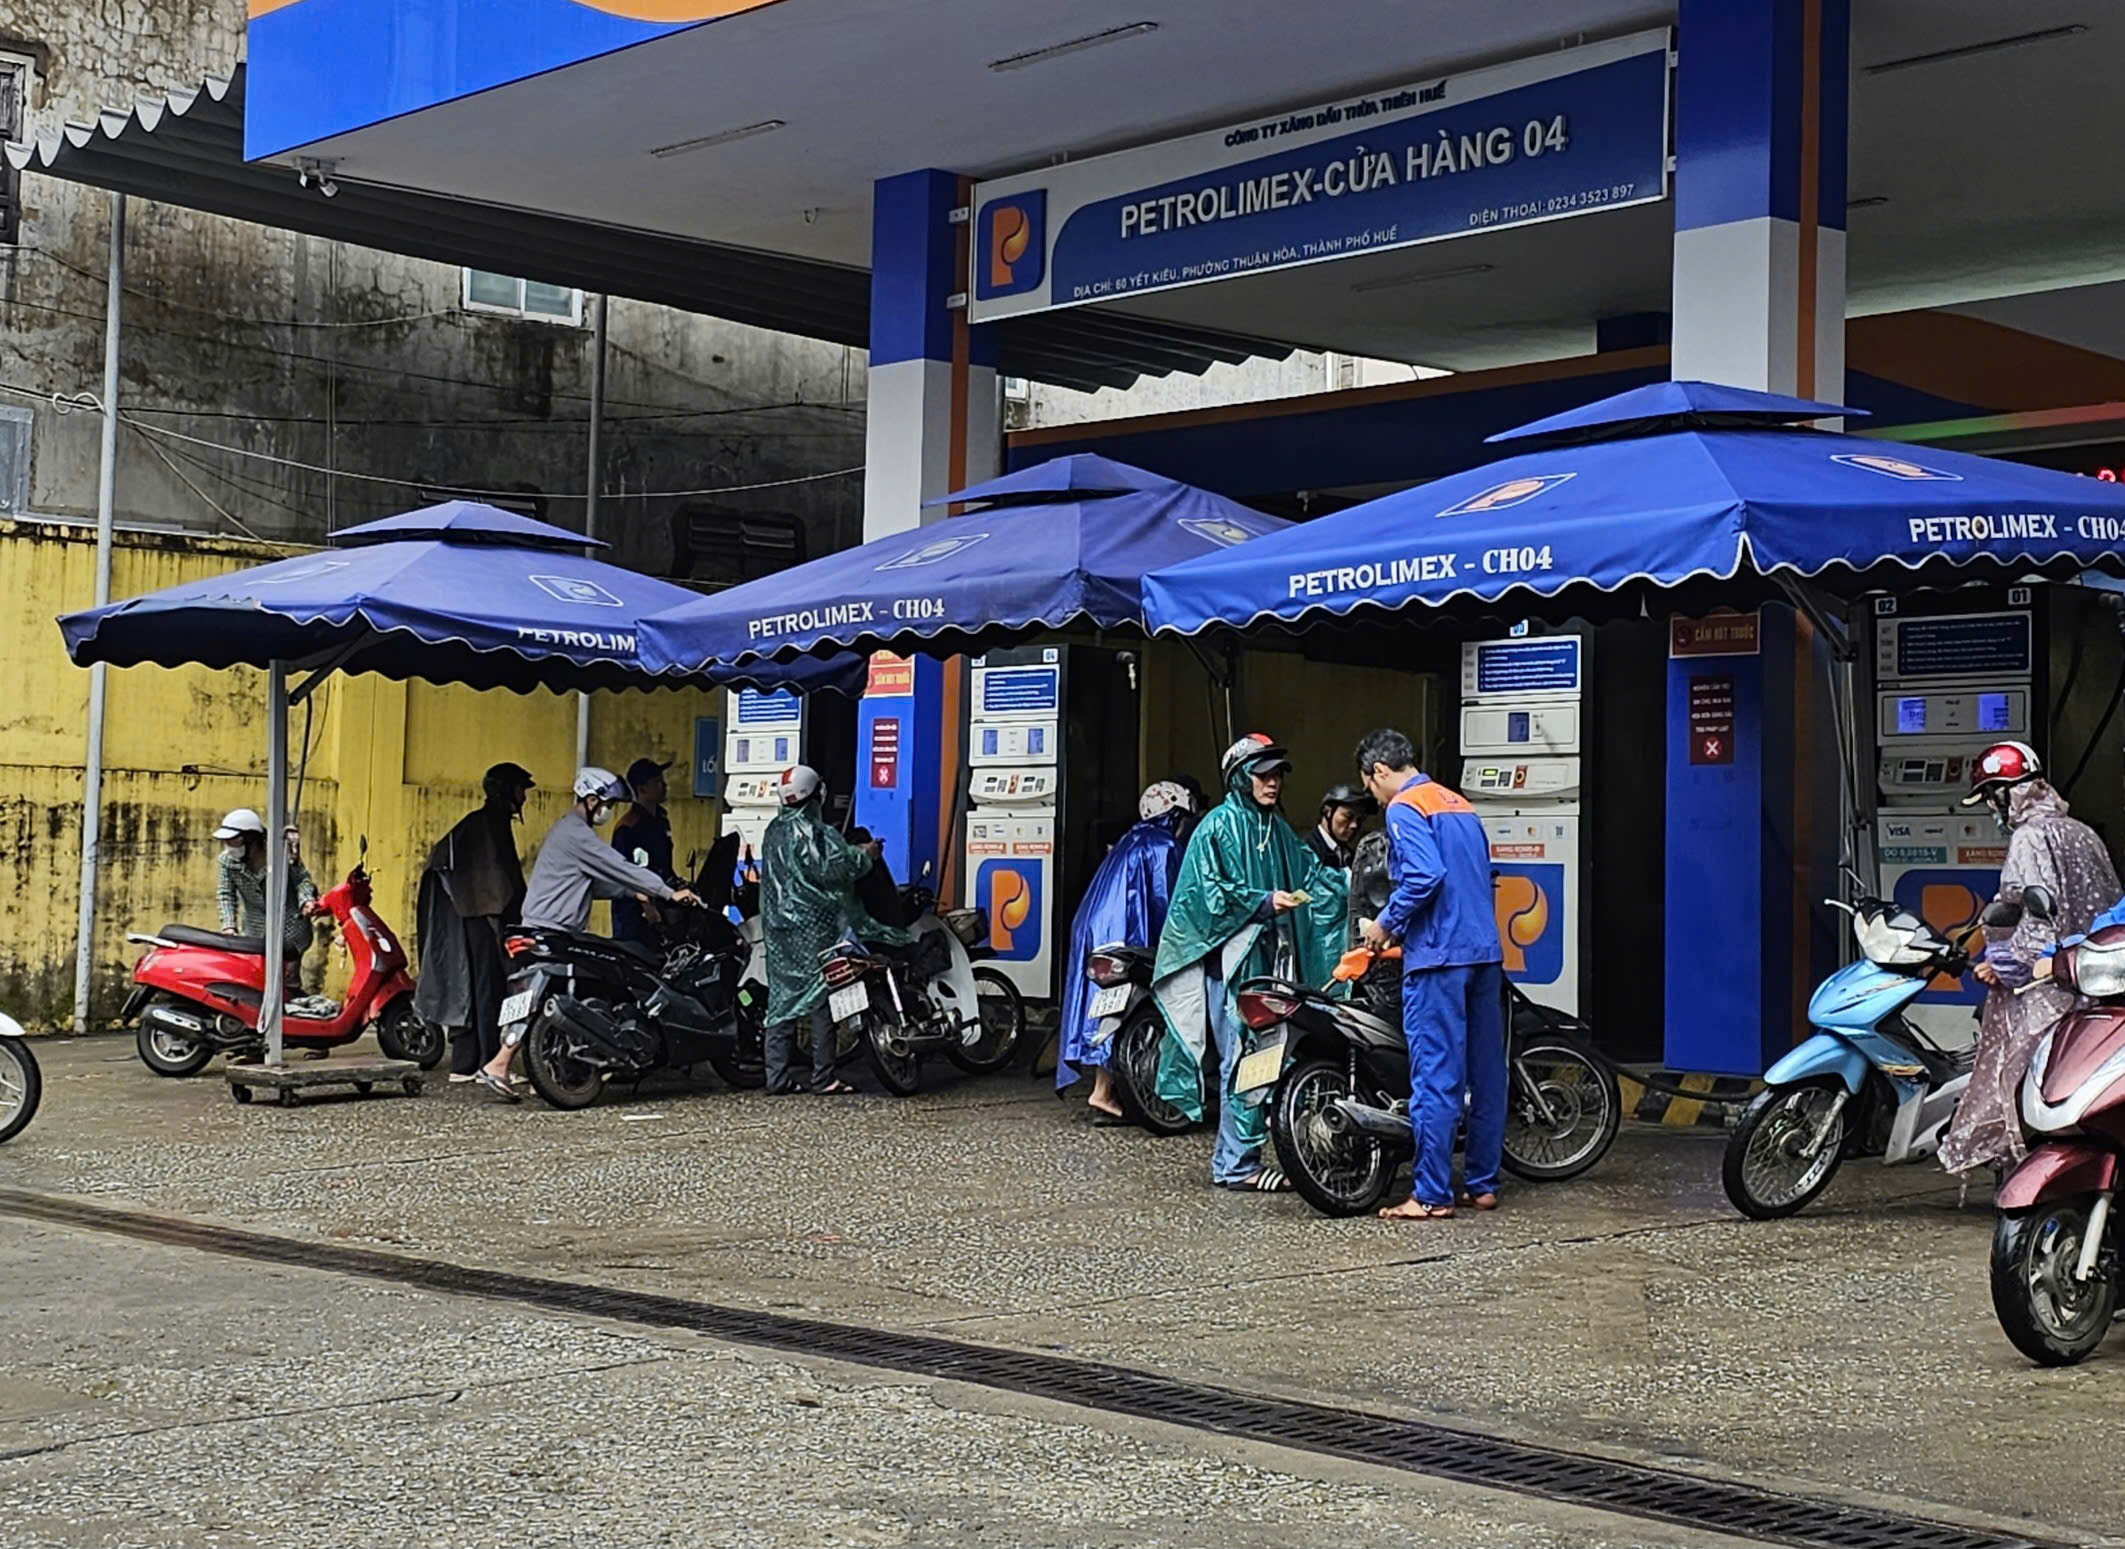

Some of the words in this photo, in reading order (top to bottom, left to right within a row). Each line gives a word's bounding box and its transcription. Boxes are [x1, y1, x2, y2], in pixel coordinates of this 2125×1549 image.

[1224, 126, 1258, 148] CÔNG
[1260, 123, 1279, 140] TY
[1279, 115, 1314, 136] XĂNG
[1379, 90, 1417, 112] THIÊN
[1419, 79, 1448, 104] HUẾ
[1120, 146, 1396, 239] PETROLIMEX-CỬA
[1406, 126, 1512, 182] HÀNG
[1524, 115, 1568, 157] 04
[1502, 199, 1545, 219] THOẠI:
[1547, 194, 1576, 211] 0234
[1580, 188, 1608, 205] 3523
[1612, 183, 1634, 199] 897
[1115, 279, 1127, 291] 60
[1128, 272, 1150, 289] YẾT
[1182, 258, 1230, 279] PHƯỜNG
[1232, 250, 1270, 271] THUẬN
[1303, 236, 1342, 256] THÀNH
[1345, 229, 1371, 248] PHỐ
[1373, 223, 1398, 242] HUẾ
[1908, 514, 2058, 543] PETROLIMEX
[1288, 553, 1457, 598] PETROLIMEX
[1482, 545, 1553, 574] CH04
[1878, 600, 1894, 612] 02
[2013, 590, 2028, 603] 01
[748, 601, 874, 640] PETROLIMEX
[892, 598, 945, 620] CH04
[517, 627, 638, 653] PETROLIM
[1888, 826, 1911, 836] VISA
